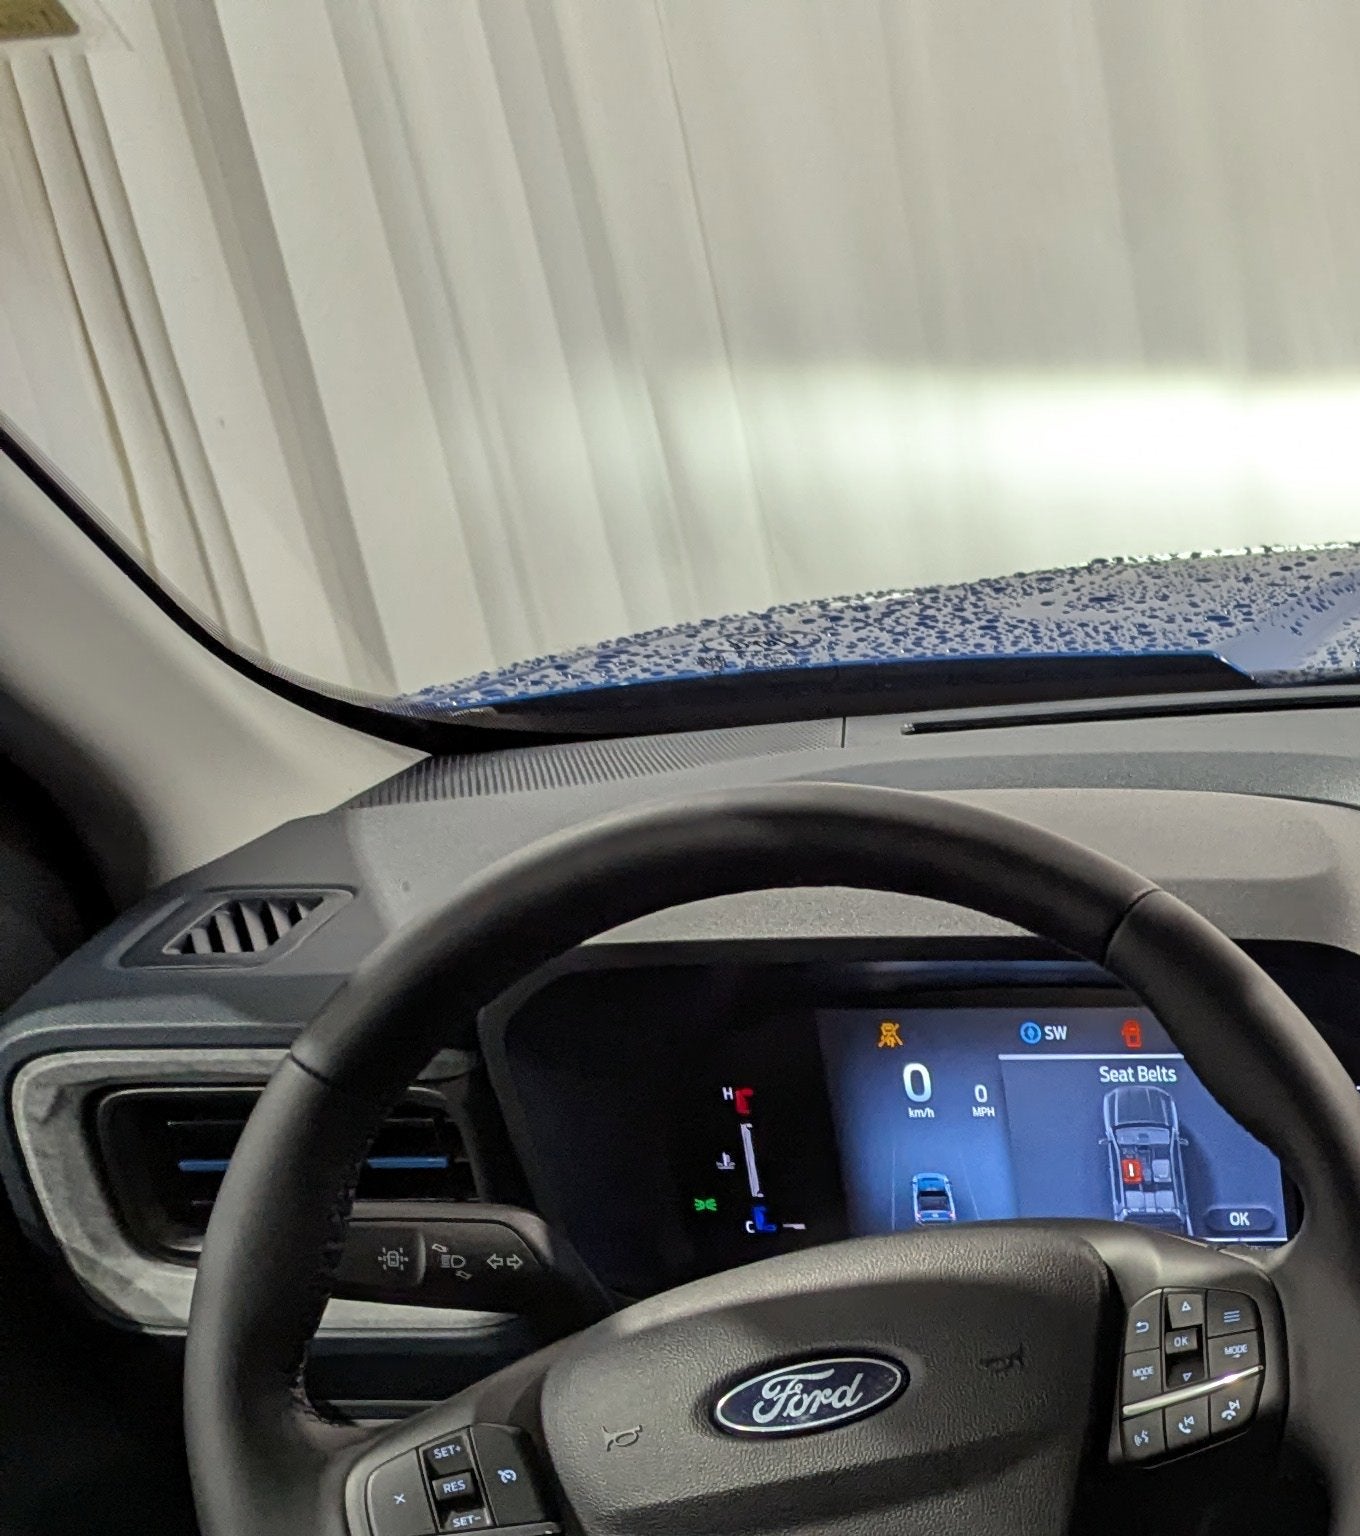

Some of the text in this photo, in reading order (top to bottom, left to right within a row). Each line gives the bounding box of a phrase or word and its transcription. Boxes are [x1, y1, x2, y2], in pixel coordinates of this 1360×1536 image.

[1044, 1025, 1068, 1041] SW
[1099, 1065, 1177, 1083] Seat Belts
[903, 1062, 932, 1103] 0
[722, 1086, 734, 1100] H
[974, 1084, 989, 1103] 0
[908, 1106, 935, 1119] km/h
[972, 1106, 996, 1118] MPH
[1229, 1211, 1251, 1227] OK
[745, 1220, 756, 1233] C
[1173, 1336, 1189, 1348] OK
[1224, 1344, 1248, 1355] MODE
[1132, 1366, 1154, 1378] MODE
[752, 1368, 864, 1424] Ford
[442, 1480, 466, 1494] RES
